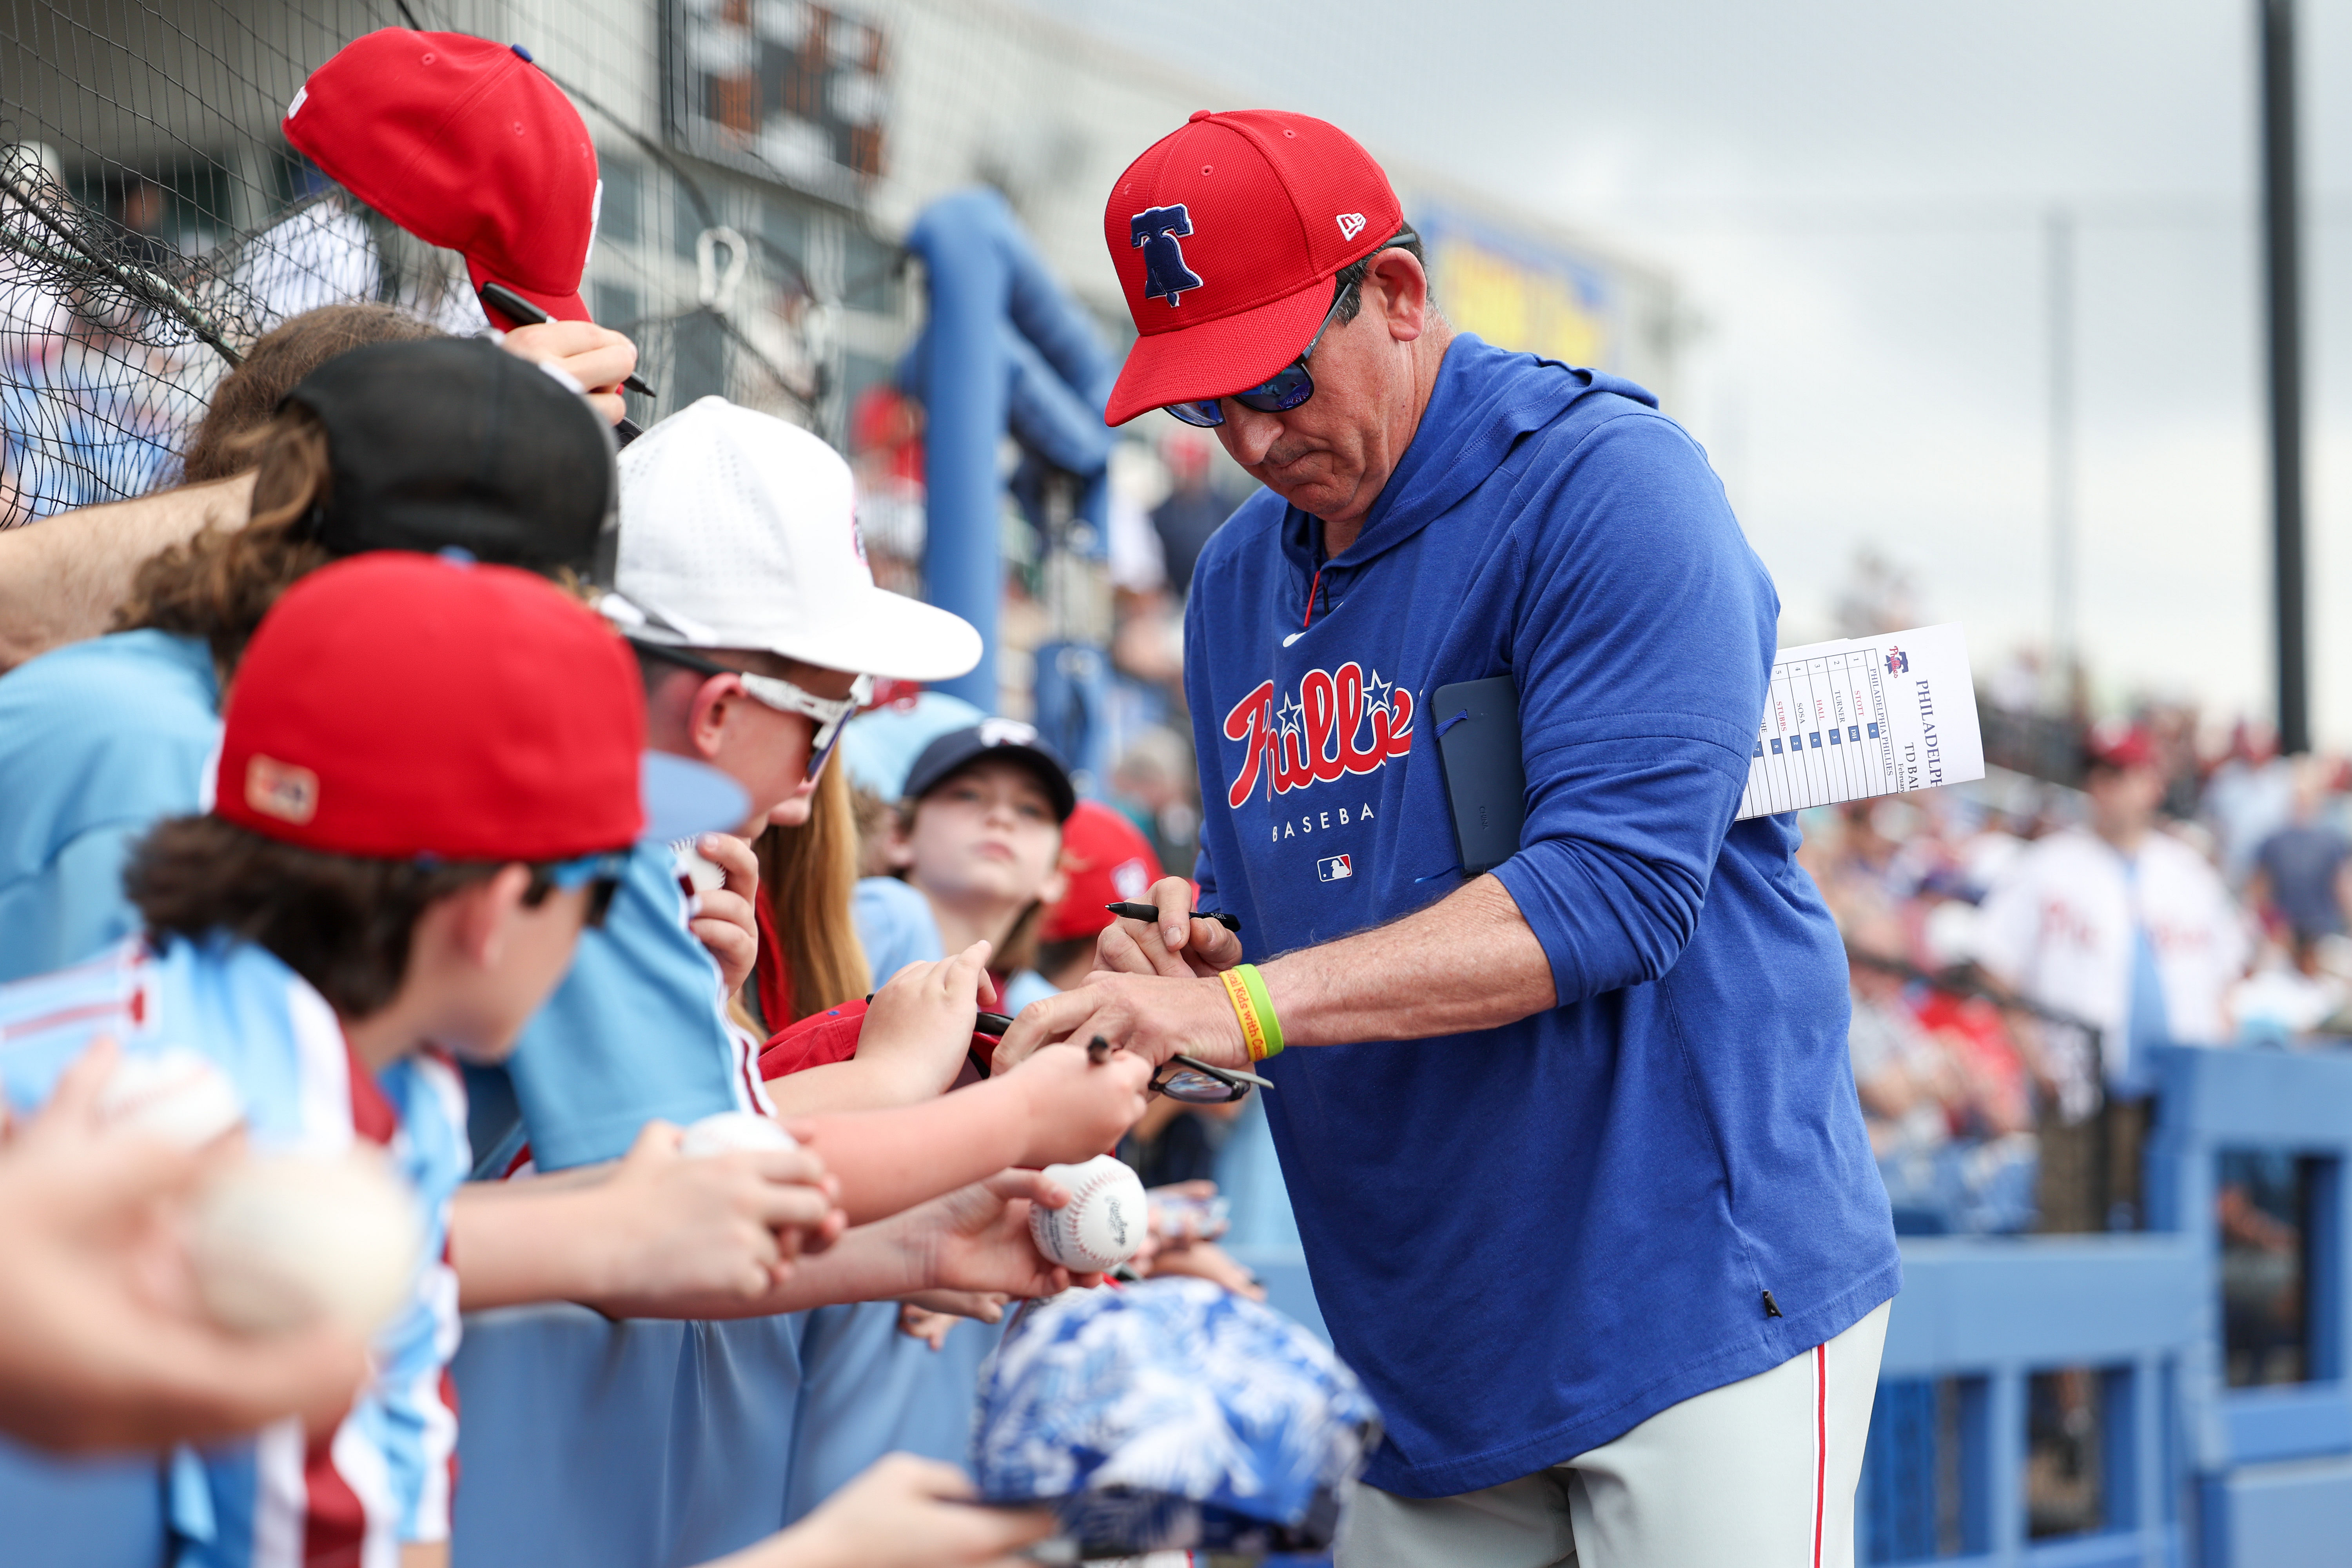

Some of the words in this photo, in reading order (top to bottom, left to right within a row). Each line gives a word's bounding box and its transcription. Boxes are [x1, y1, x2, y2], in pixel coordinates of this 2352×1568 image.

[1889, 646, 1900, 678] Phillies
[1776, 701, 1787, 731] STUBBS
[1797, 703, 1805, 724] SOSA
[1816, 700, 1825, 721] HALL
[1835, 690, 1846, 723] TURNER
[1851, 729, 1857, 739] DH
[1855, 690, 1864, 717] STOTT
[1223, 661, 1414, 809] Phillie
[1870, 668, 1887, 734] PHILADELPHIA
[1882, 737, 1893, 776] PHILLIES
[1904, 742, 1916, 762] TD
[1272, 802, 1374, 842] BASEBA
[1479, 806, 1488, 830] CHINA
[1234, 986, 1249, 1009] Kids
[1244, 1010, 1259, 1038] with
